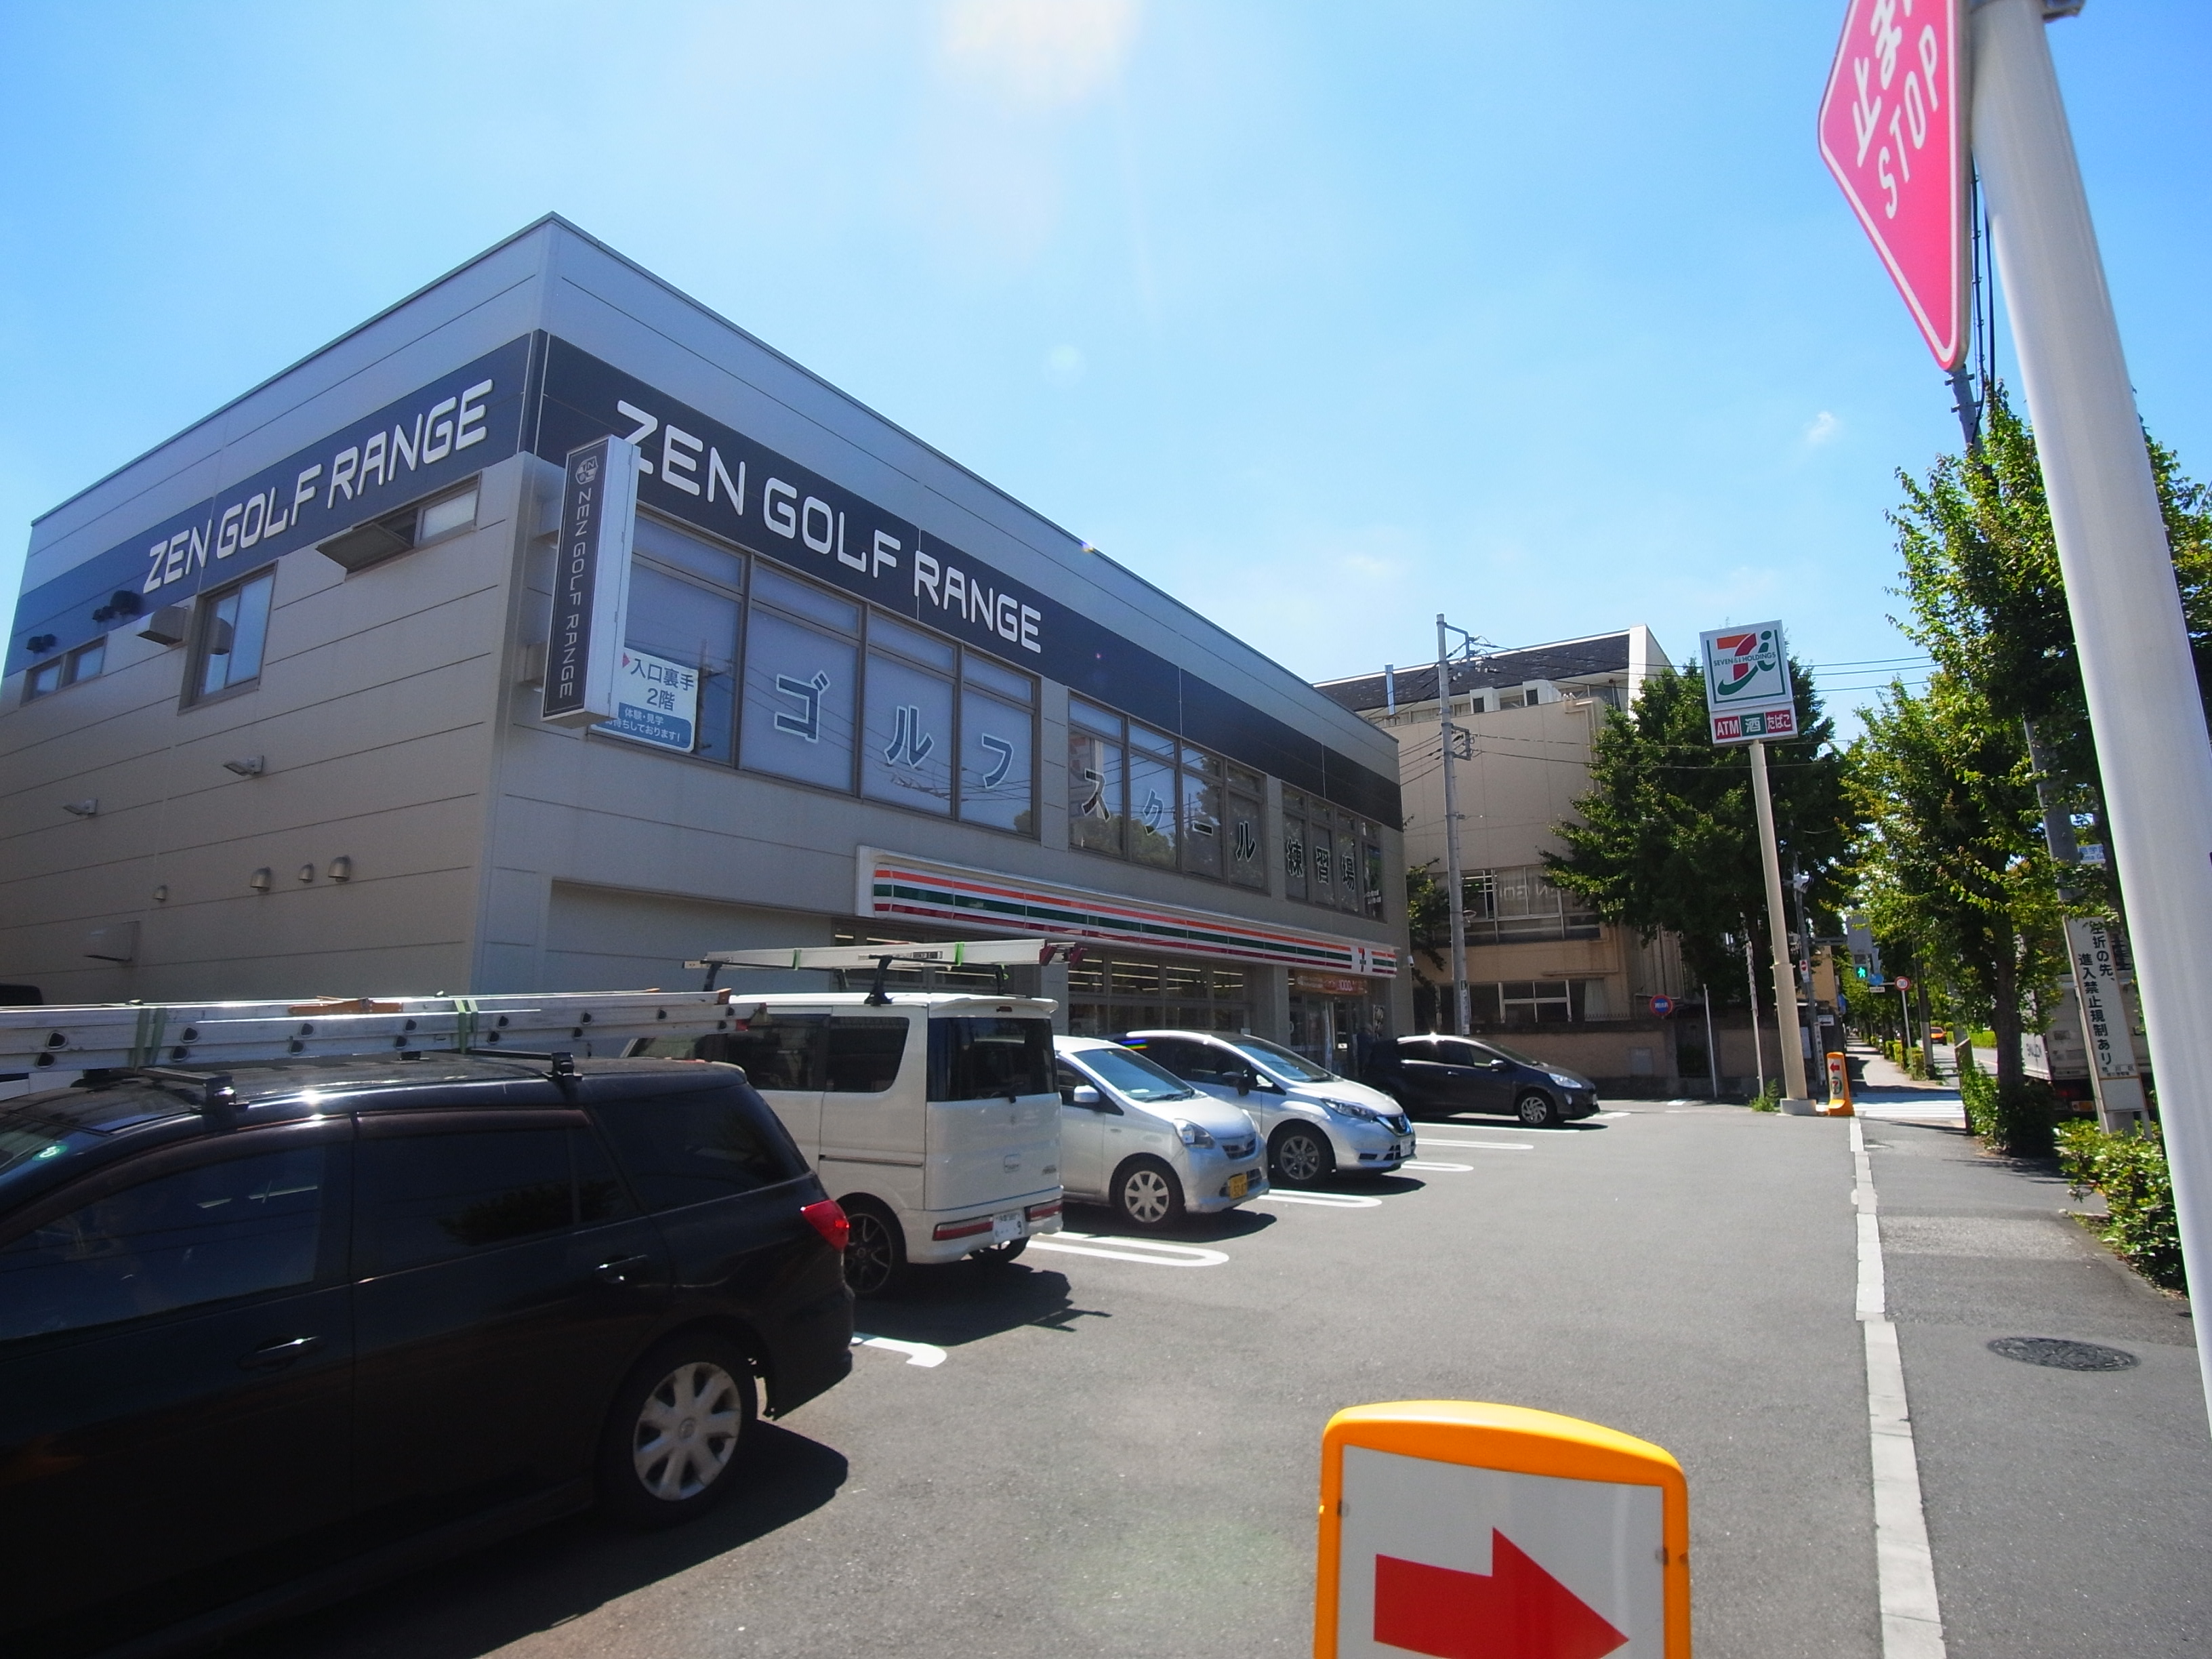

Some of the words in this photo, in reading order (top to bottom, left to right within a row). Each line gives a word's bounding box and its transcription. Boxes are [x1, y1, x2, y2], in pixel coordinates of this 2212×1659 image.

[1853, 0, 1913, 168] 止ま
[1878, 24, 1938, 220] STOP
[144, 520, 213, 594] ZEN
[217, 464, 323, 559] GOLF
[327, 379, 493, 509] RANGE
[575, 487, 592, 537] ZEN
[617, 400, 745, 516] ZEN
[763, 477, 901, 578] GOLF
[914, 549, 1042, 653] RANGE
[569, 541, 587, 606] GOLF
[559, 613, 579, 699] RANGE
[630, 658, 694, 691] 入口裏手
[1713, 657, 1734, 667] SEVEN
[1742, 651, 1776, 662] HOLDINGS
[624, 707, 664, 725] 体験・見学
[647, 688, 675, 711] 2階
[1744, 717, 1761, 733] 酒
[1767, 714, 1791, 731] たばこ
[1717, 720, 1740, 736] ATM
[1286, 836, 1355, 892] 練習場
[2078, 953, 2112, 1065] 進入禁止規制あり
